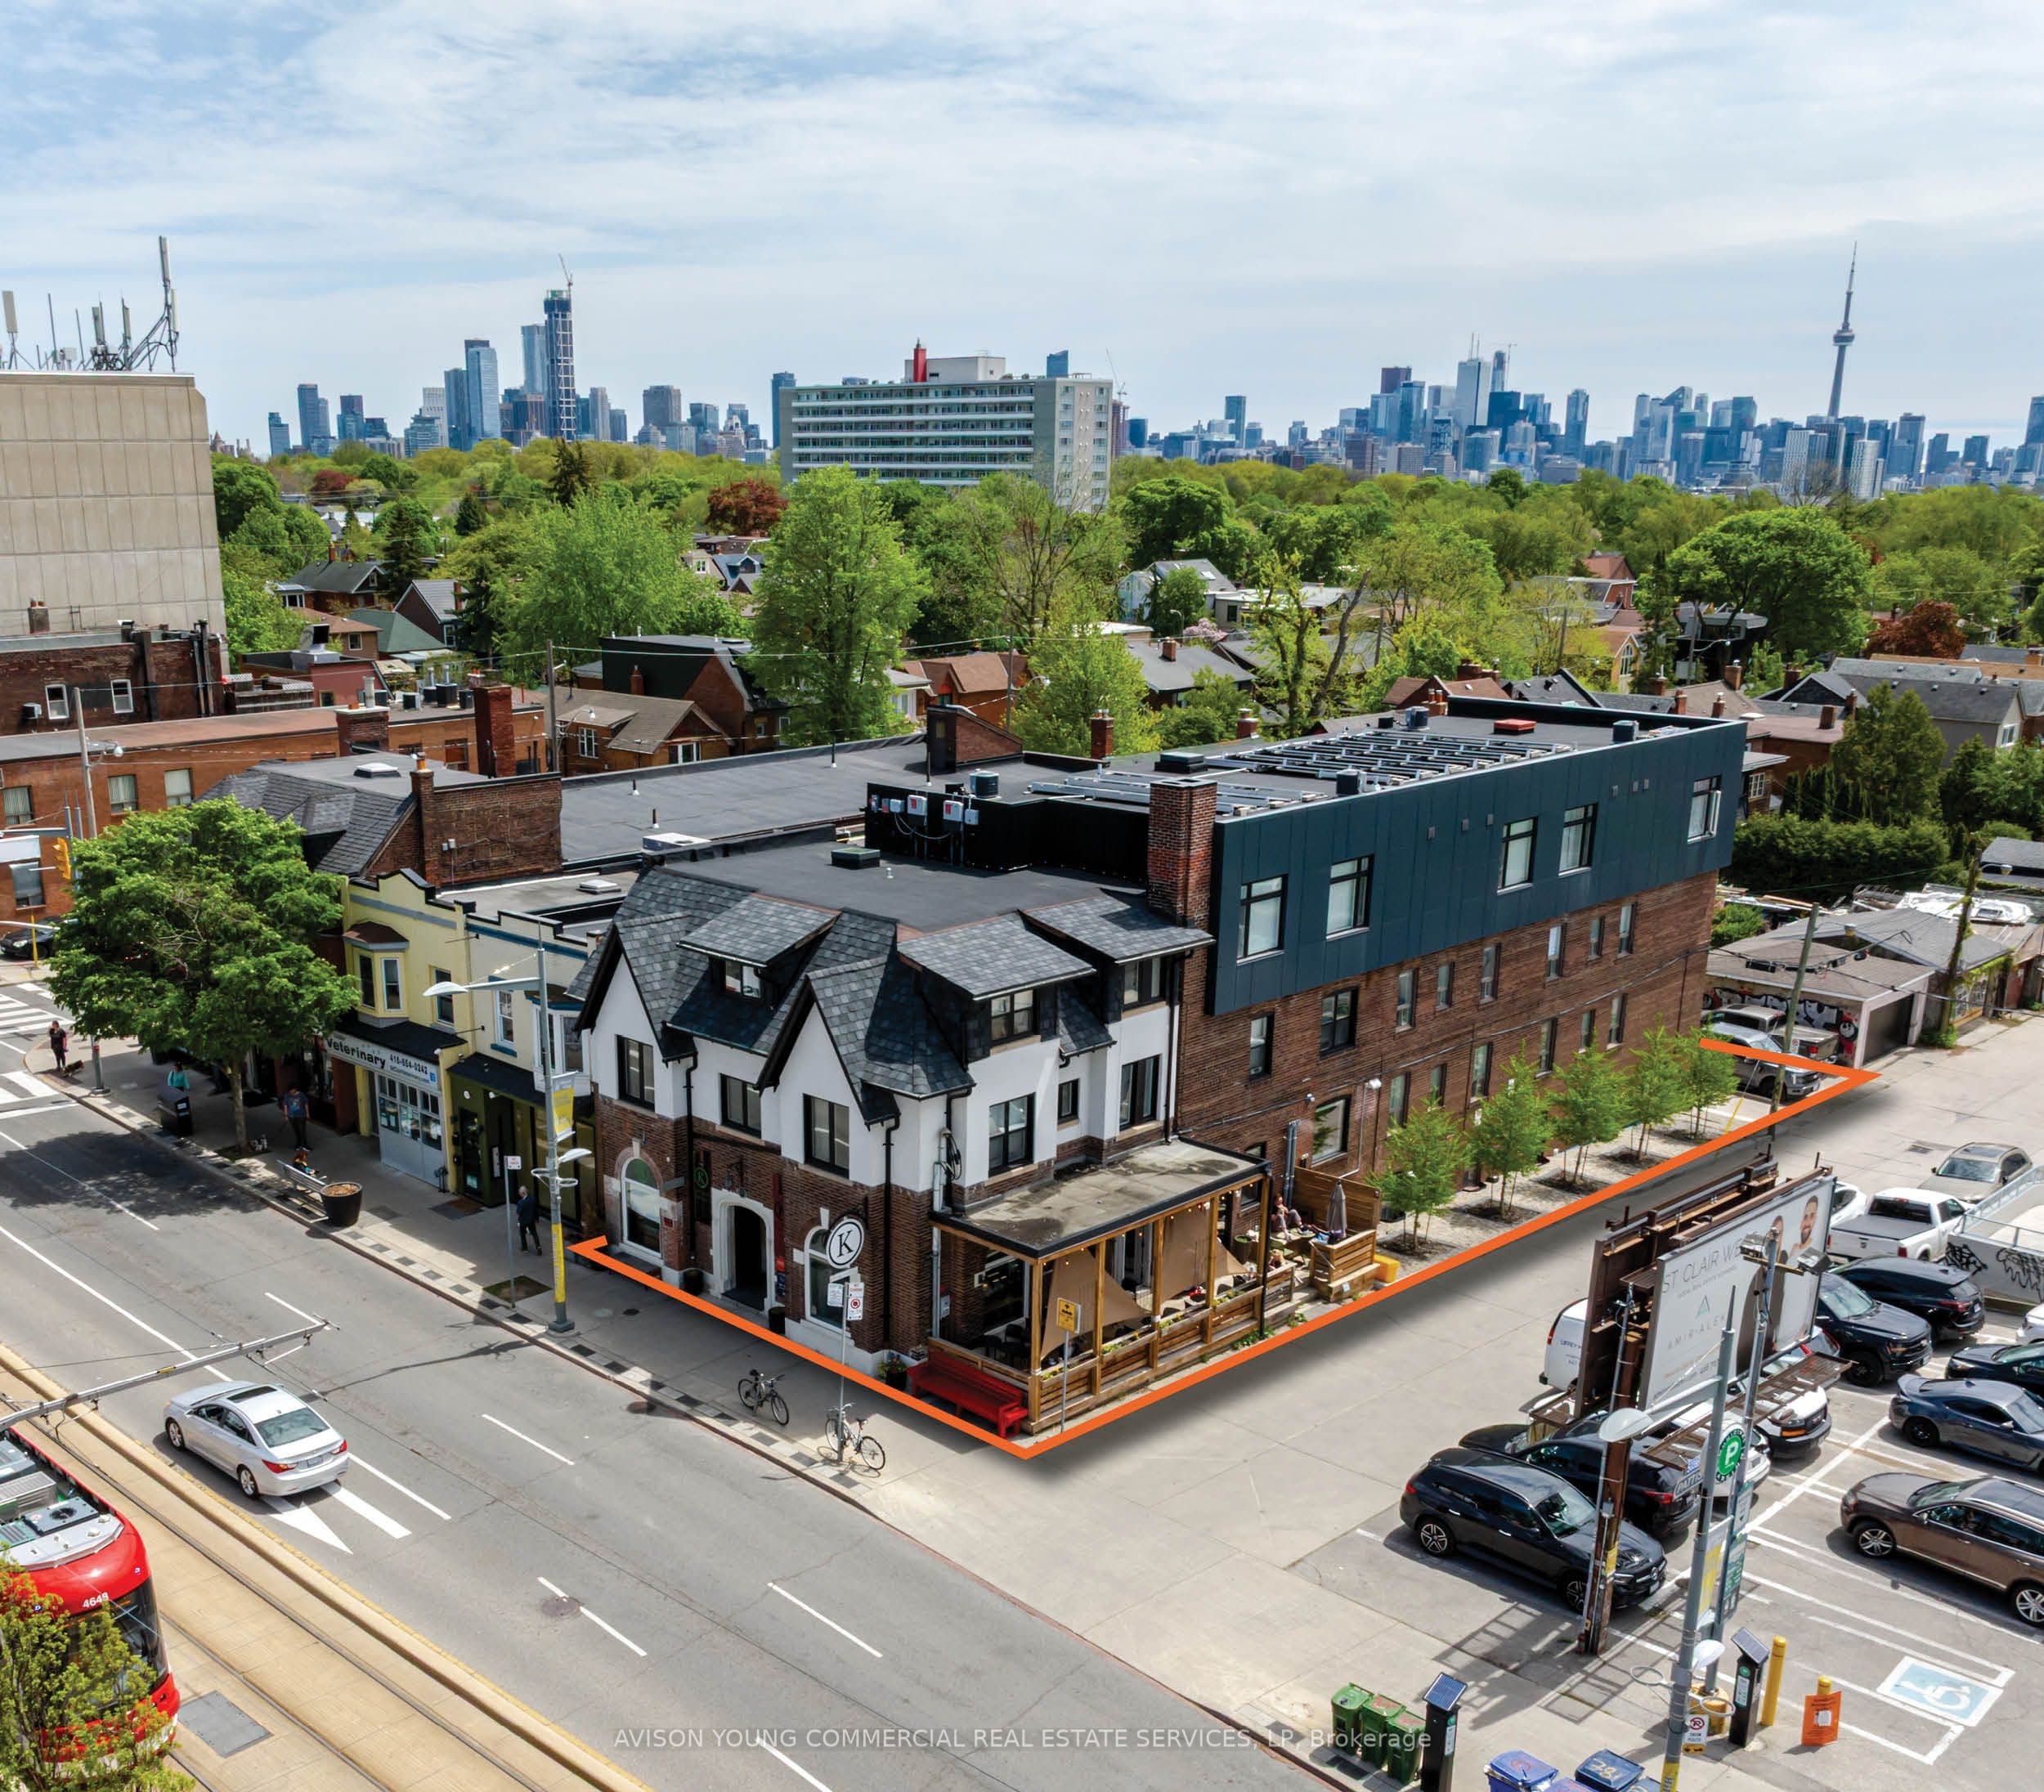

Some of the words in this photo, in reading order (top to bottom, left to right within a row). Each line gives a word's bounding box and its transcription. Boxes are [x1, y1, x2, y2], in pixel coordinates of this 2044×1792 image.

[327, 1038, 386, 1068] Veterinary
[837, 1230, 854, 1257] K
[1661, 1269, 1679, 1293] ST
[1683, 1250, 1719, 1283] CLAIR
[1725, 1441, 1739, 1466] P
